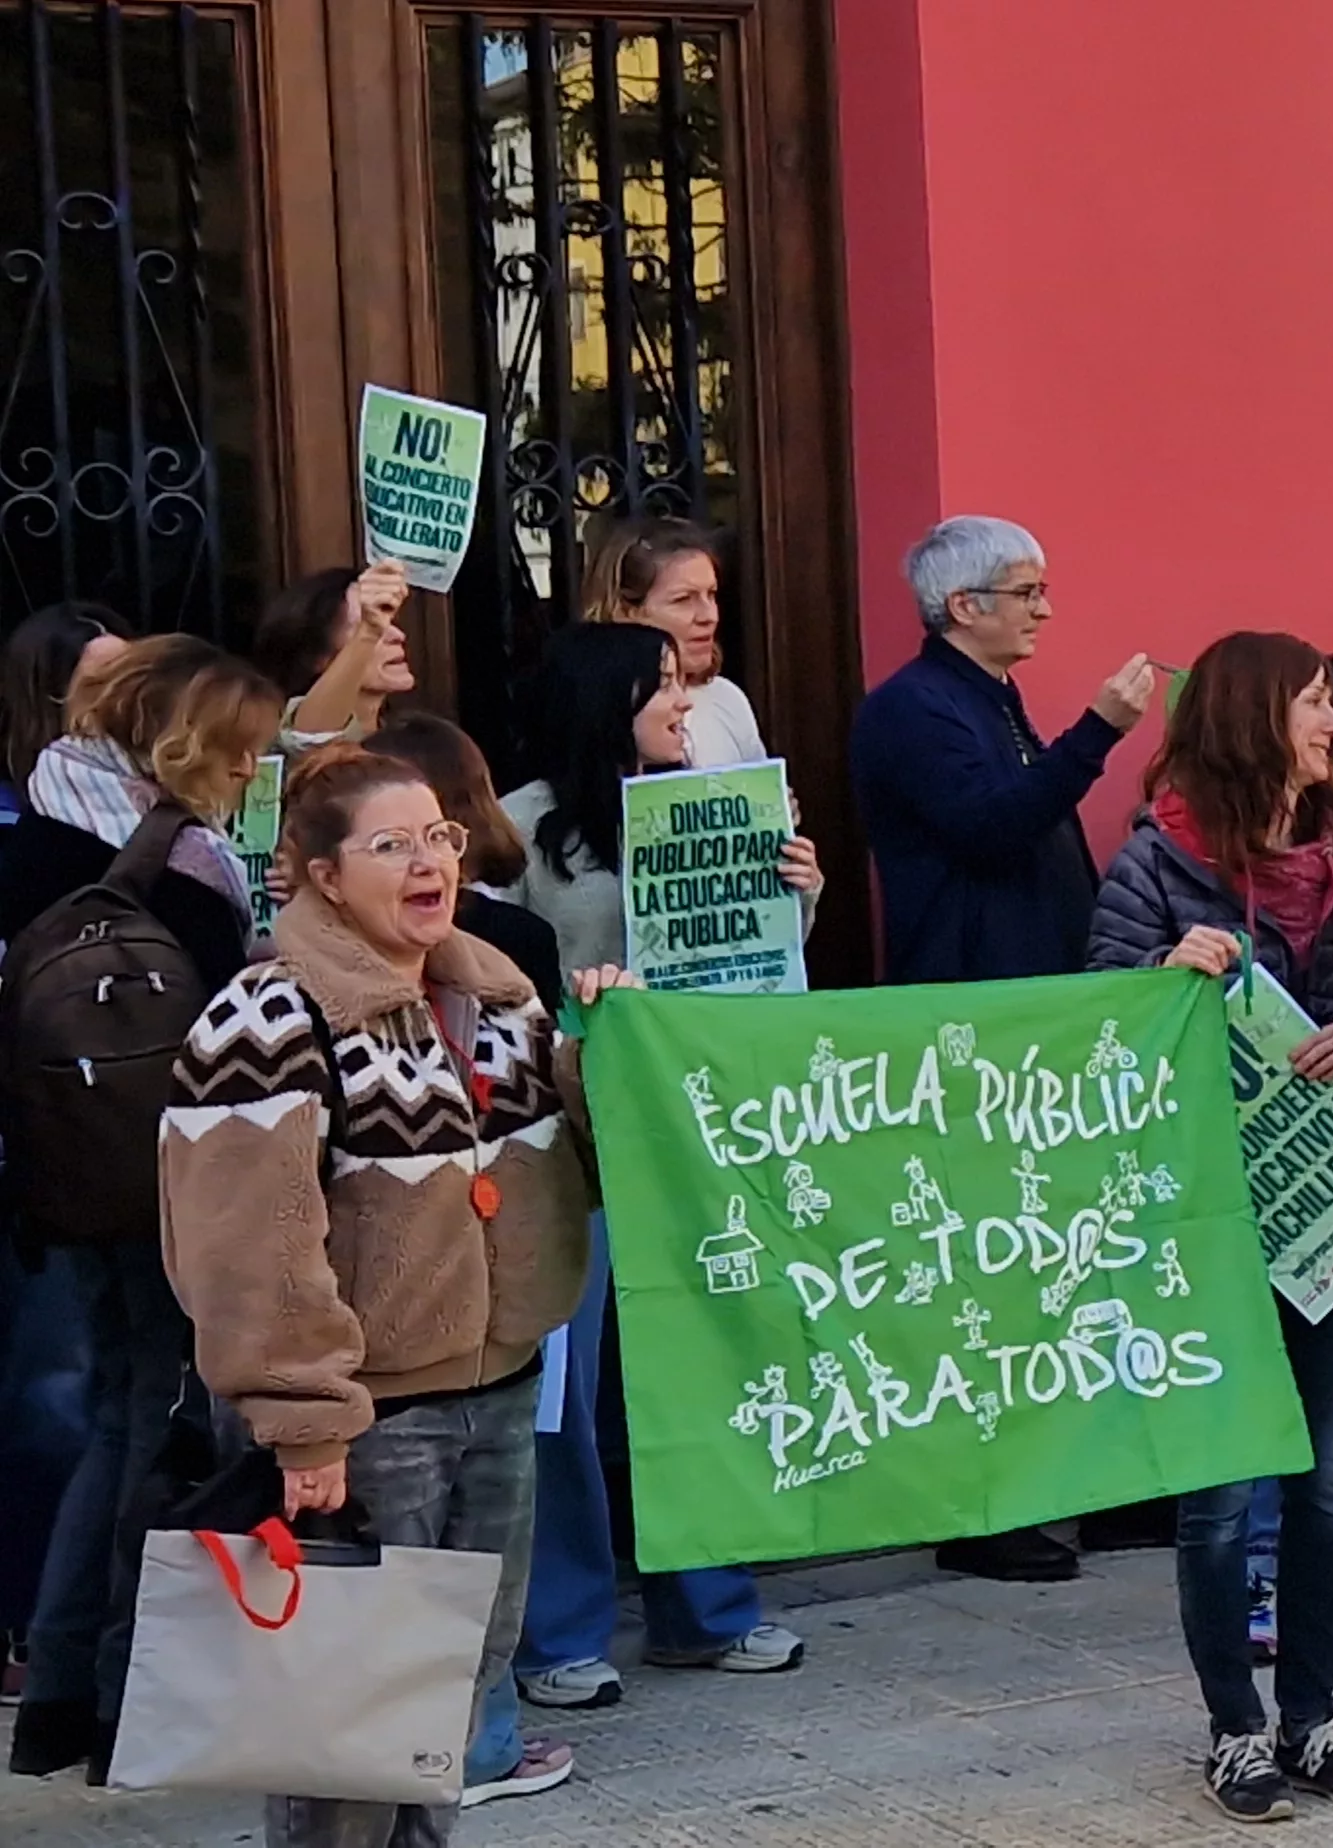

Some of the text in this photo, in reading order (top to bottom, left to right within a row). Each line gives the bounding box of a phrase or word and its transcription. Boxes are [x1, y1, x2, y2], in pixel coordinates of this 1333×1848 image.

[393, 410, 452, 465] NO!
[381, 460, 471, 500] CONCIERTO
[445, 502, 468, 527] EN
[670, 794, 751, 835] DINERO
[633, 829, 788, 878] PÚBLICO PARA
[633, 883, 662, 917] LA
[695, 1046, 948, 1167] ESCUELA
[786, 1207, 1147, 1320] DE TOD@S
[758, 1328, 1223, 1468] PARA TOD@S
[774, 1451, 867, 1493] Huesca
